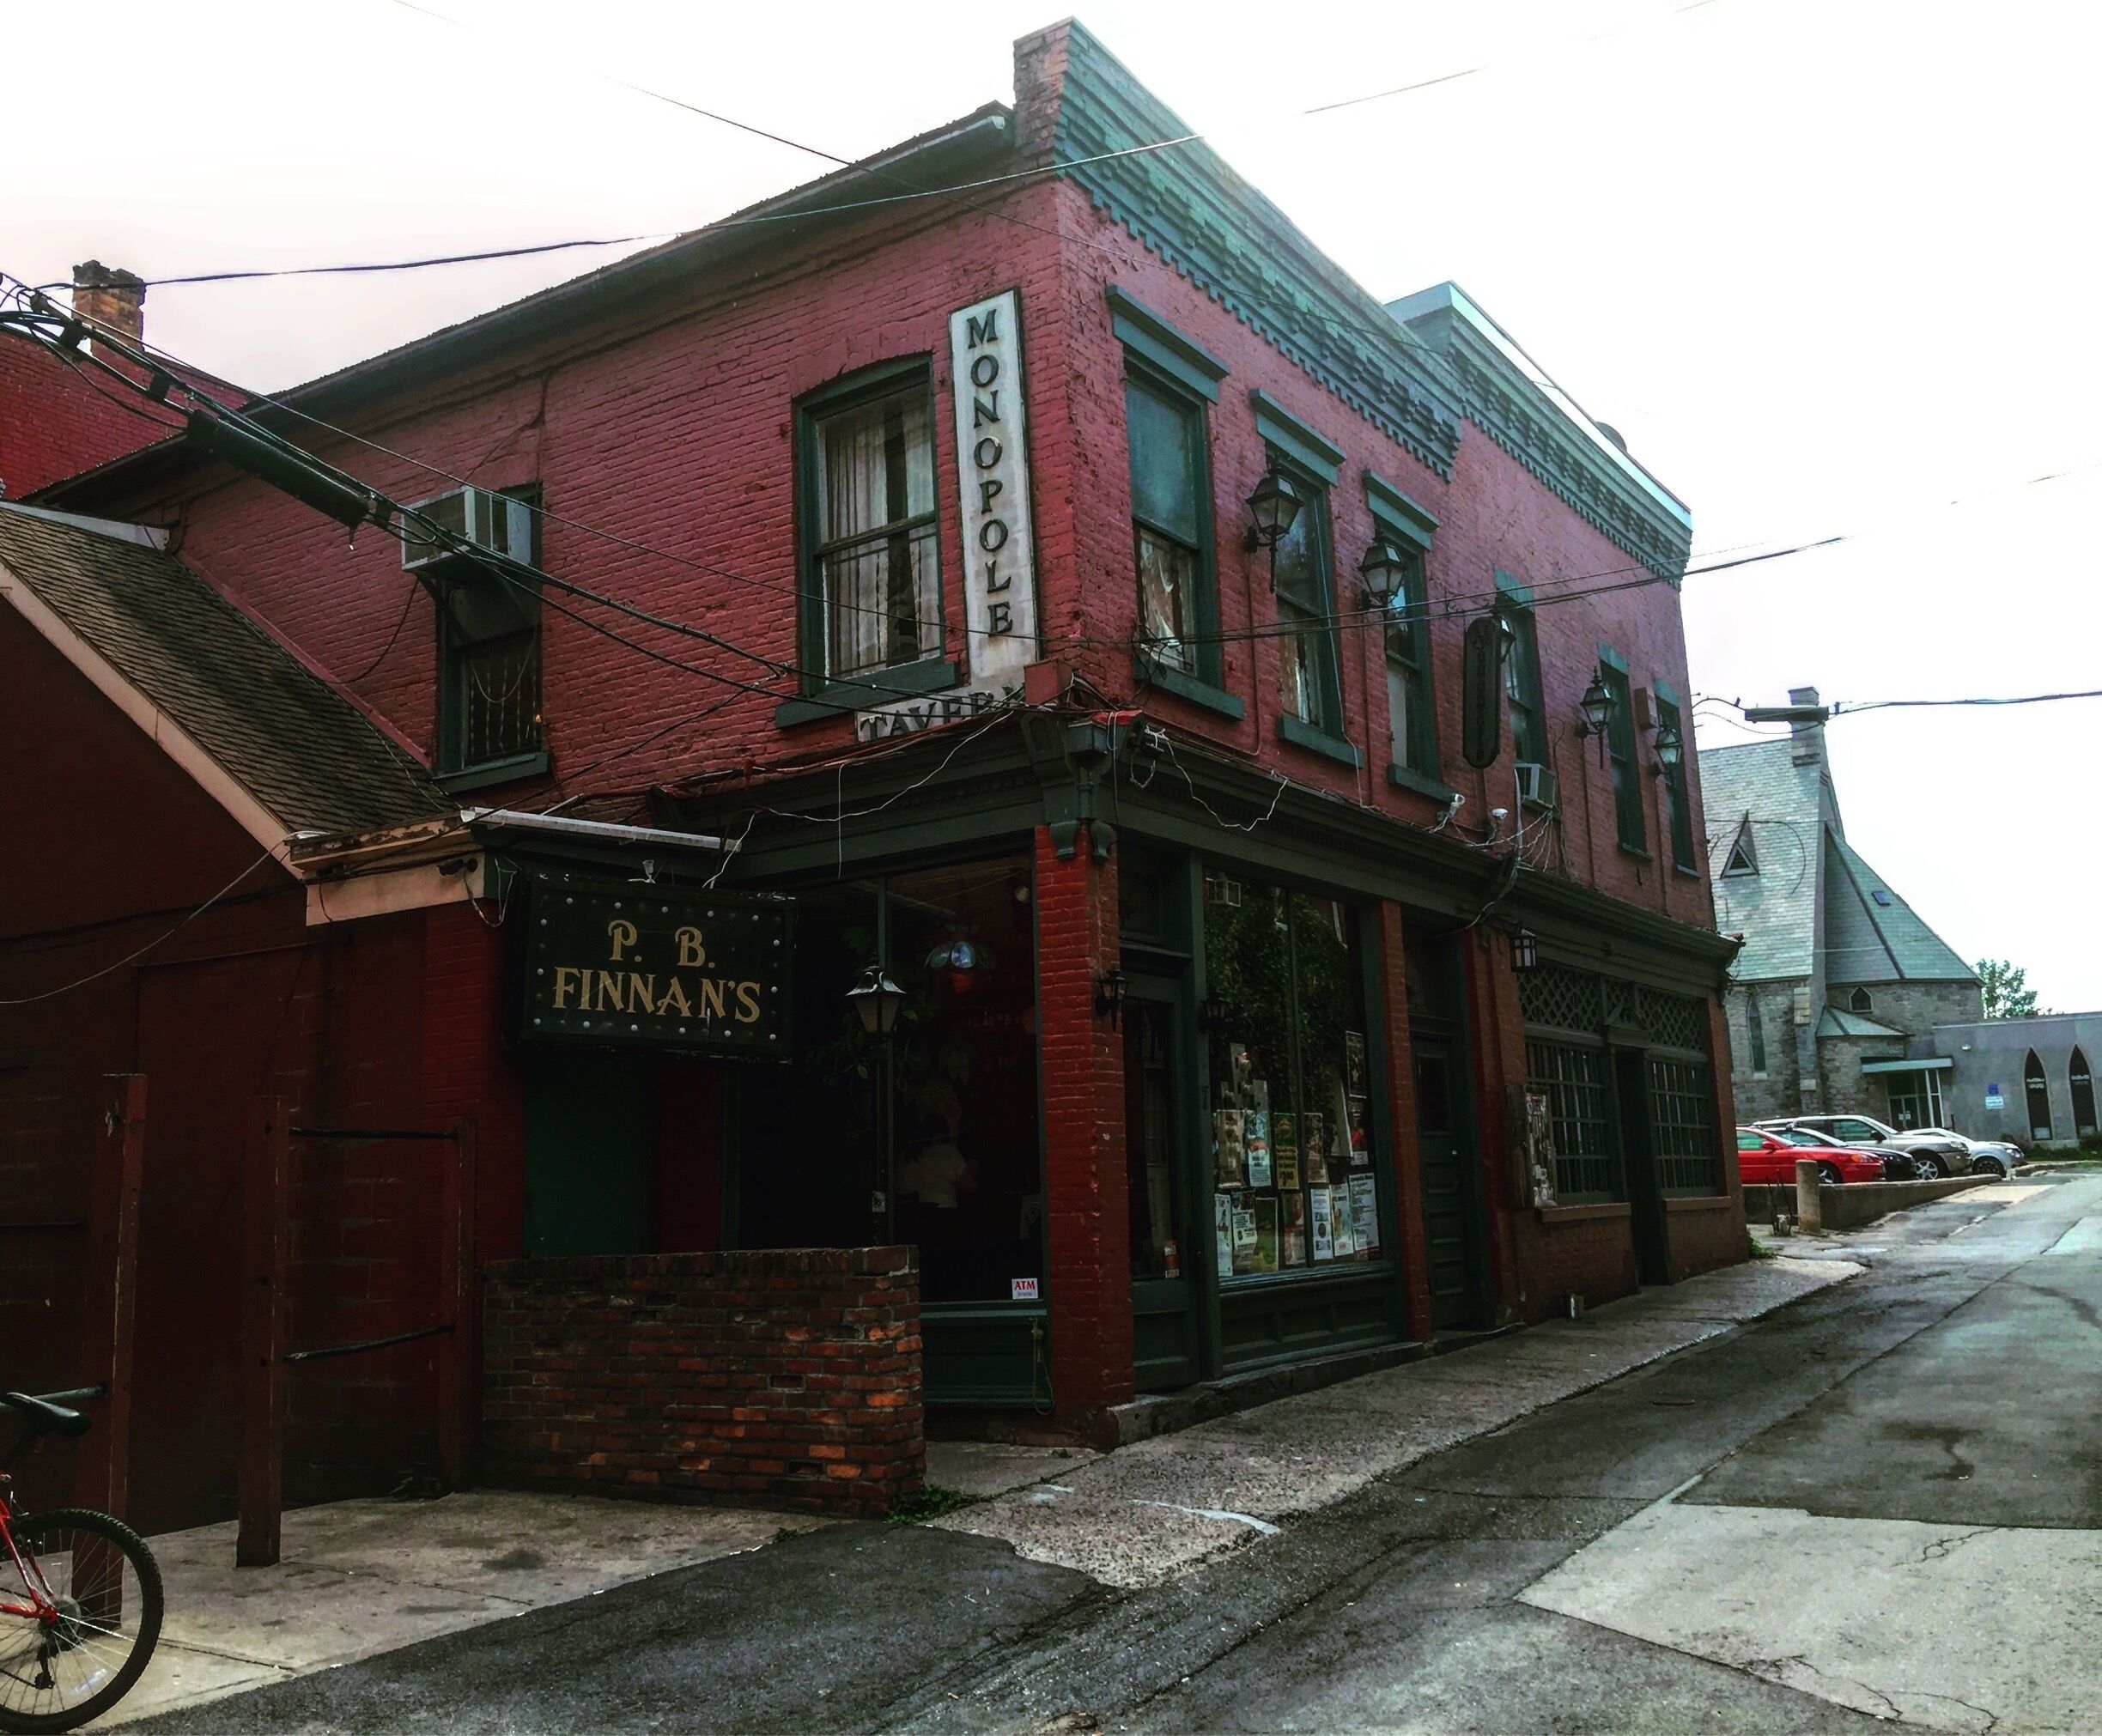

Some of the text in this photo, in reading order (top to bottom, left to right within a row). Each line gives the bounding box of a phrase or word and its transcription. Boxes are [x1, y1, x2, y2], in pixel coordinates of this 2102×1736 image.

[967, 307, 1013, 637] MONOPOLE
[608, 920, 715, 968] P. B.
[552, 967, 761, 1023] FINNAN'S
[1014, 1280, 1036, 1290] ATM
